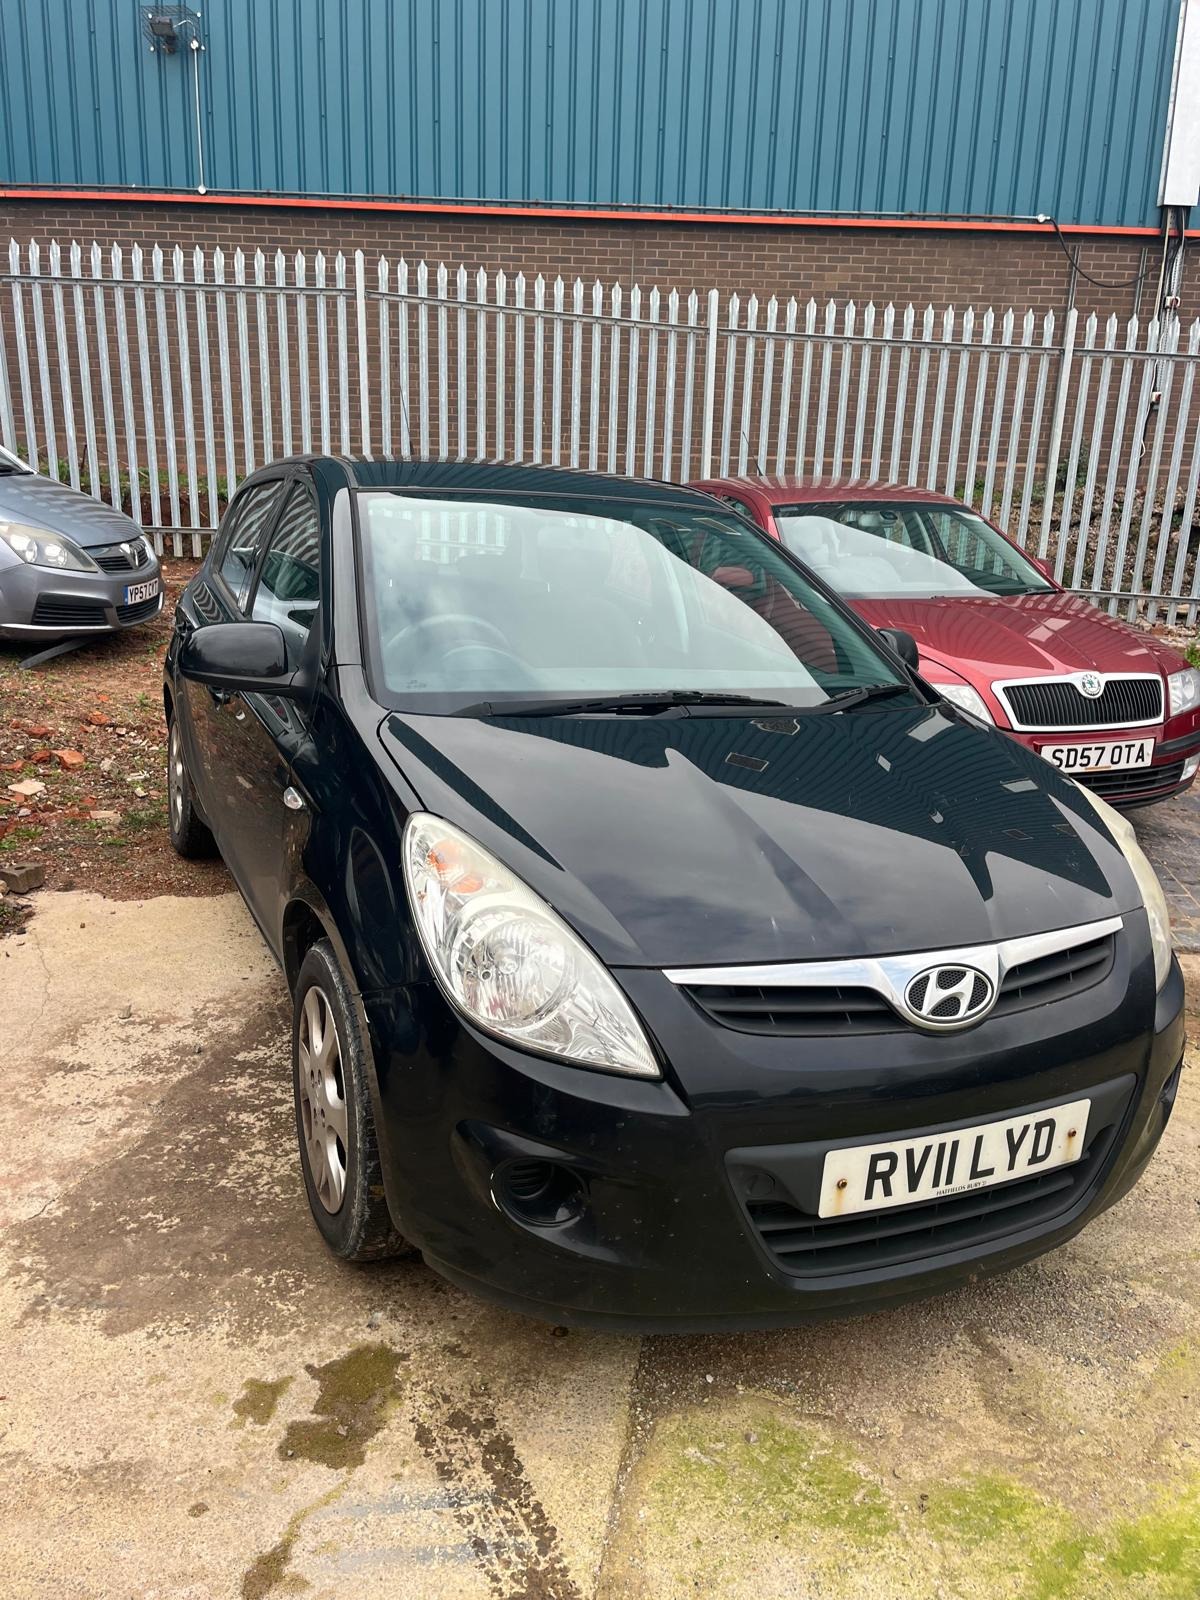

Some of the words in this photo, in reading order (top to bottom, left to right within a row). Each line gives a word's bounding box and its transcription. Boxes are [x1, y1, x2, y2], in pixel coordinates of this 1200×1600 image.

[129, 585, 147, 602] YP57
[1052, 747, 1106, 769] SD57
[1110, 743, 1145, 765] OTA
[864, 1139, 961, 1201] RV11
[968, 1117, 1057, 1181] LYD
